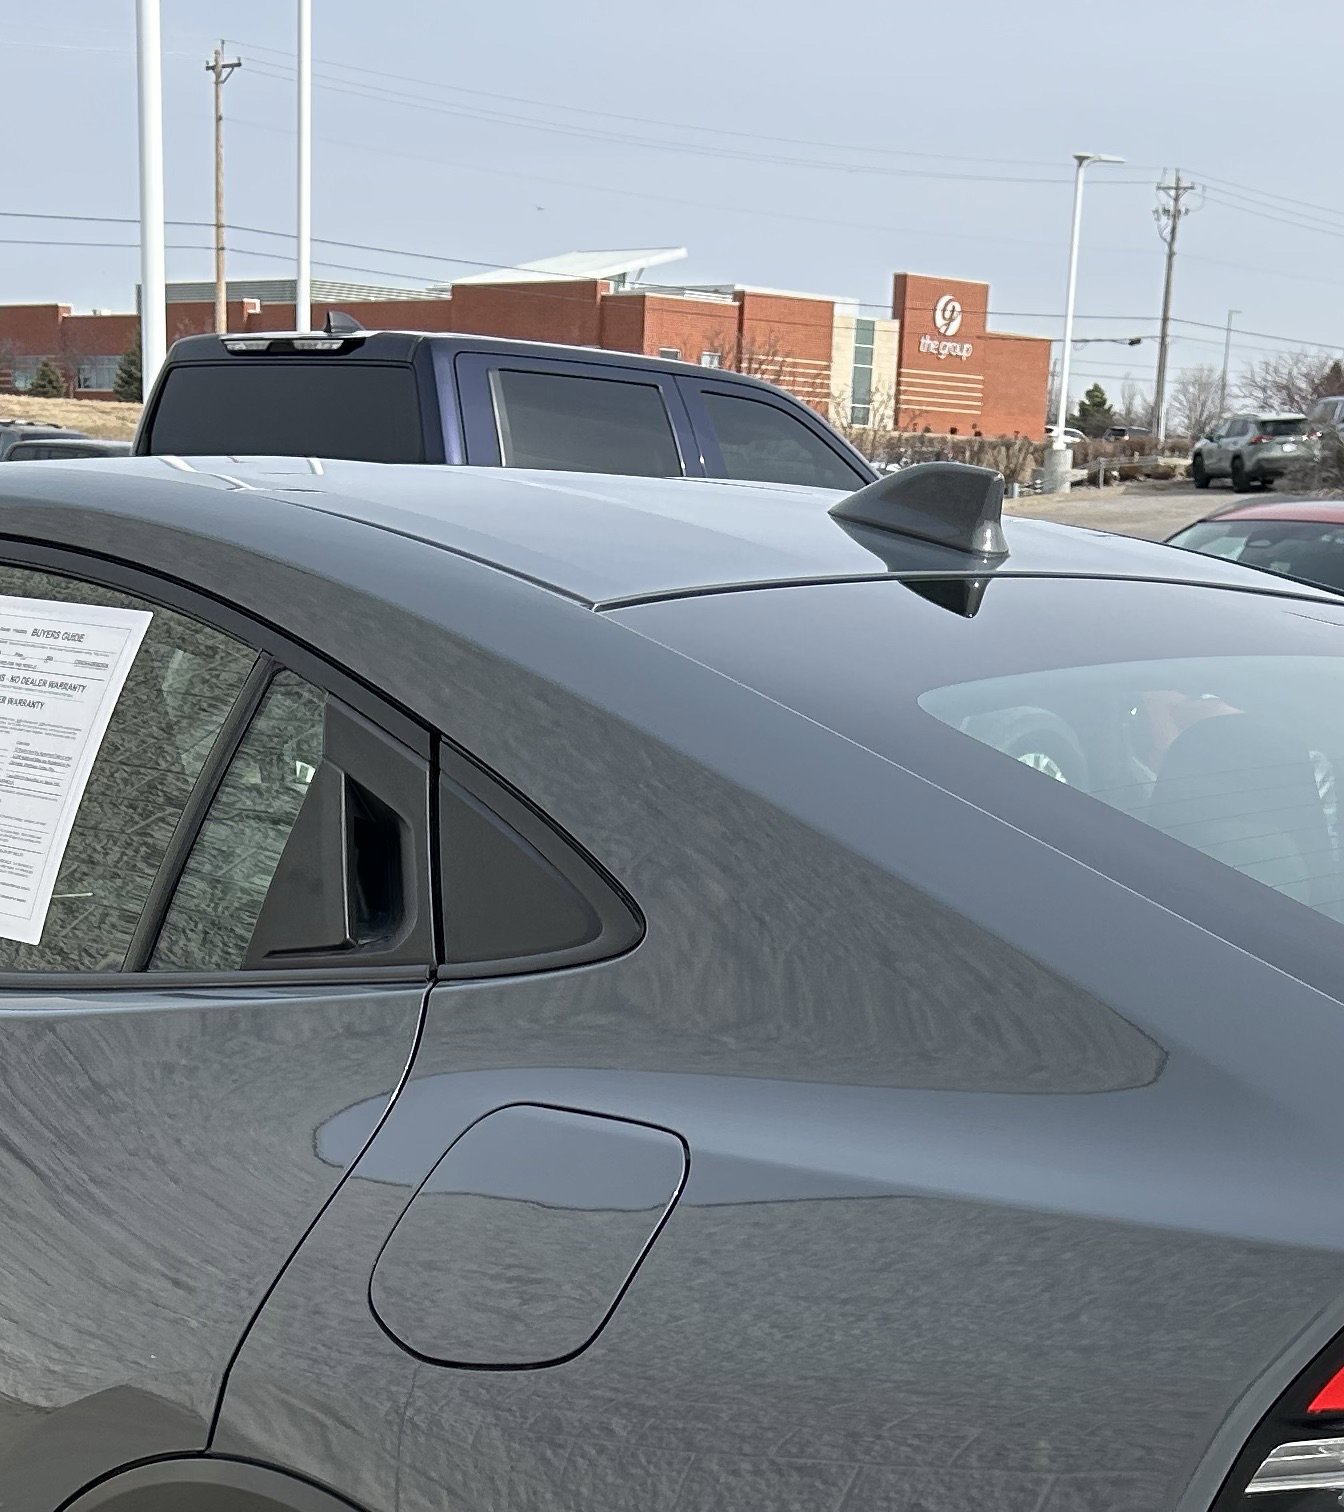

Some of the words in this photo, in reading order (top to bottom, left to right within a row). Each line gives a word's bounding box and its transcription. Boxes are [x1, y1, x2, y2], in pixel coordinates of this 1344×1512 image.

[919, 335, 938, 354] the
[938, 340, 973, 360] group
[30, 627, 61, 640] BUYERS
[61, 631, 85, 642] GUIDE
[21, 676, 47, 688] DEALER
[47, 681, 87, 693] WARRANTY
[7, 697, 45, 710] WARRANTY
